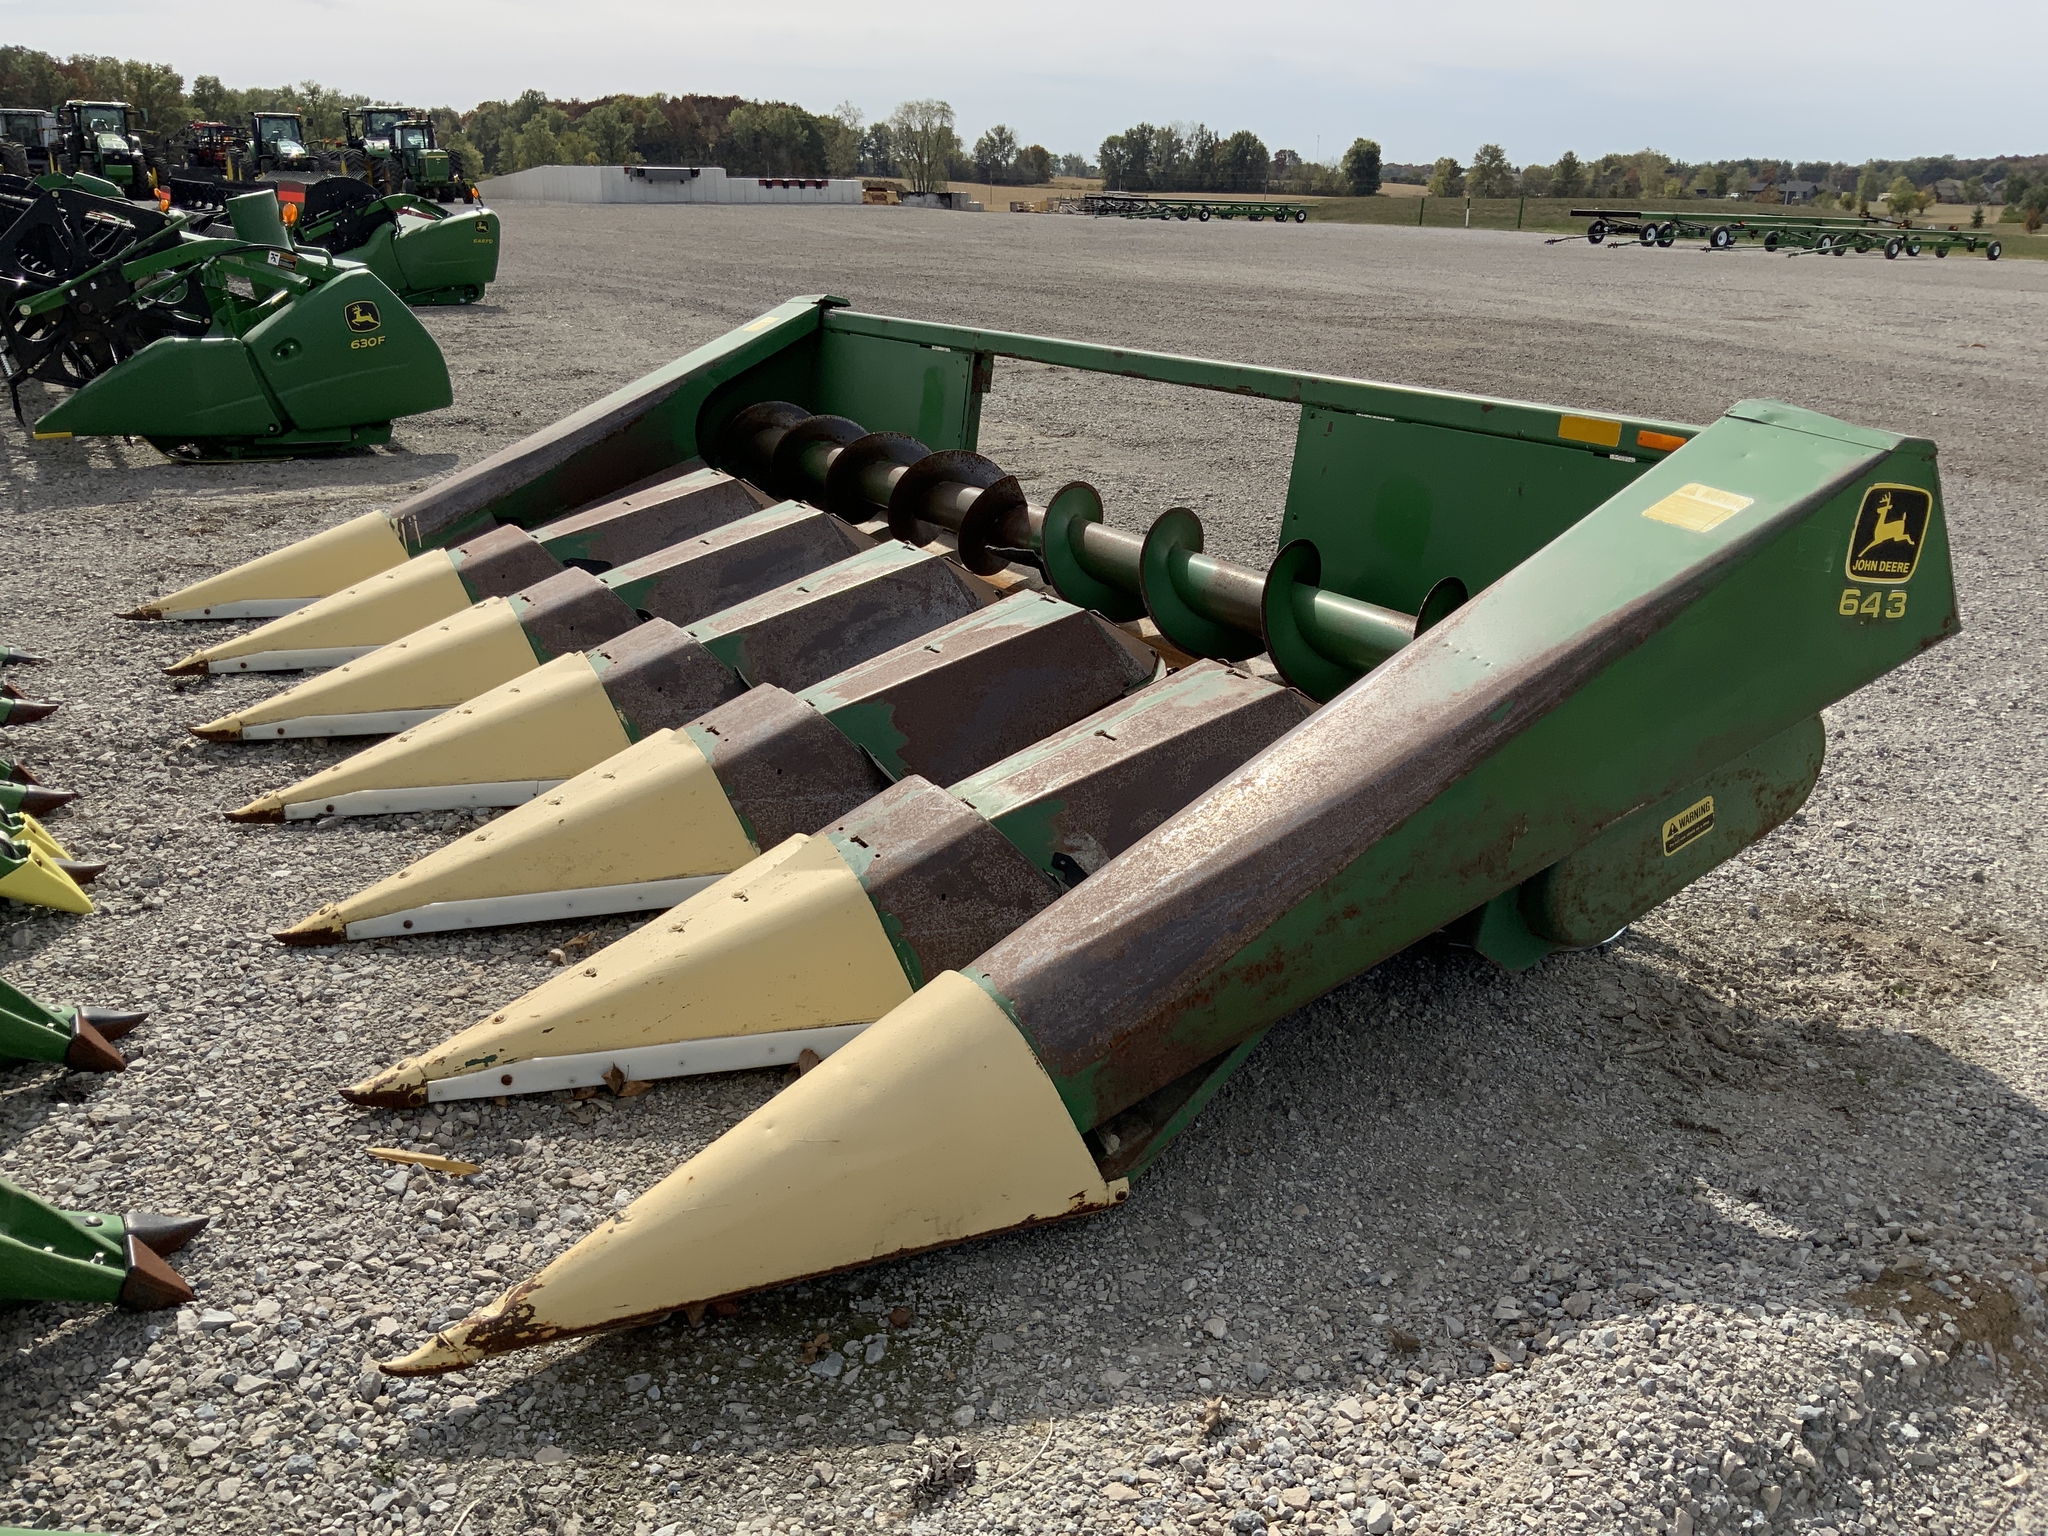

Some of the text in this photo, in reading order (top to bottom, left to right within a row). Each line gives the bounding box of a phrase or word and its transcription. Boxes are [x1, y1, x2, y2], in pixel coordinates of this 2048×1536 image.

[350, 335, 386, 349] 630F
[1852, 559, 1911, 573] JOHN DEERE
[1838, 588, 1908, 619] 643
[1678, 801, 1711, 829] WARNING
